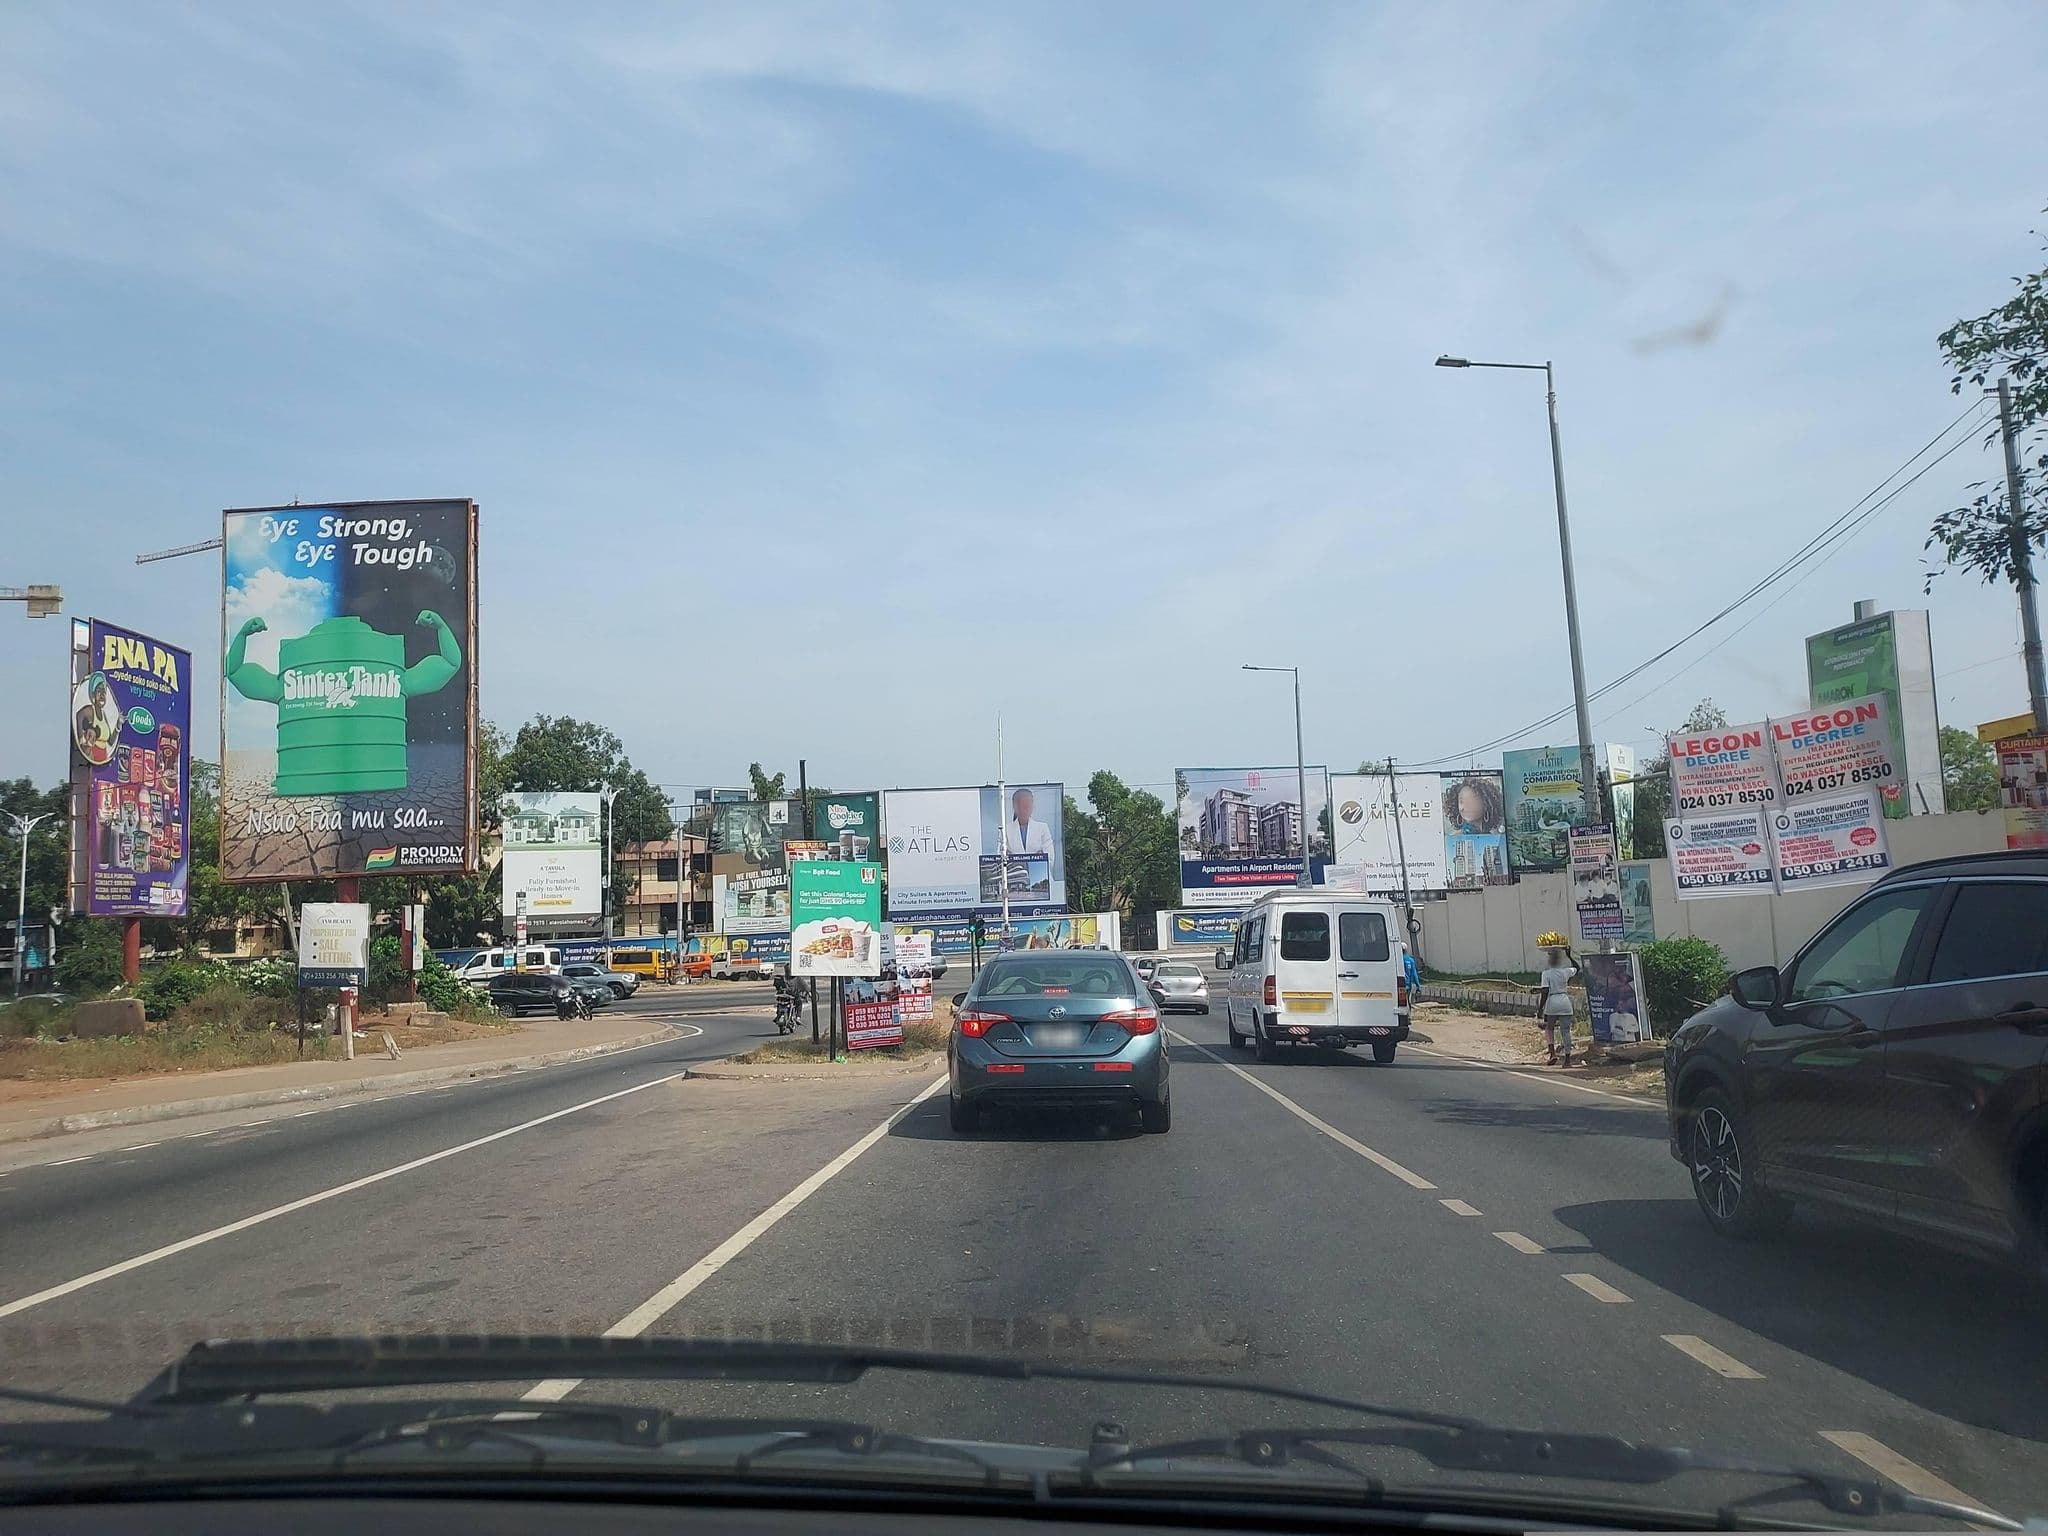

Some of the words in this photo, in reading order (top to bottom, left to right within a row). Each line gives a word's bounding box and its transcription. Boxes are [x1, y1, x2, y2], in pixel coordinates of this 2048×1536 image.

[317, 516, 413, 541] Strong,
[352, 540, 433, 570] Tough
[103, 635, 149, 671] ENA
[153, 646, 179, 692] PA
[284, 669, 348, 700] Sintex
[348, 666, 401, 698] Tank
[1774, 703, 1878, 741] LEGON
[1671, 731, 1761, 757] LEGON
[1792, 723, 1865, 750] DEGREE
[2000, 739, 2041, 750] CURTAIN
[1686, 749, 1750, 767] DEGREE
[1784, 753, 1820, 765] ENTRANCE
[1823, 748, 1844, 758] EXAM
[1805, 753, 1860, 769] REQUIREMENT
[1680, 772, 1712, 781] ENTRANCE
[1714, 769, 1732, 778] EXAM
[1734, 766, 1765, 776] CLASSES
[1786, 772, 1799, 782] NO
[1840, 762, 1853, 771] NO
[1855, 755, 1886, 768] SSSCE
[1524, 773, 1581, 784] COMPARISON!
[1697, 776, 1746, 786] REQUIREMENT
[1785, 779, 1814, 796] 024
[1817, 772, 1846, 790] 037
[1851, 763, 1892, 783] 8530
[1681, 788, 1692, 796] NO
[1728, 782, 1740, 791] NO
[1742, 780, 1769, 789] SSSCE
[1680, 796, 1705, 810] 024
[1708, 792, 1733, 806] 037
[1738, 788, 1775, 803] 8530
[1371, 808, 1431, 820] MRAGE
[1793, 809, 1814, 818] GHANA
[1816, 799, 1869, 815] COMMUNICATION
[1795, 815, 1832, 826] TECHNOLOGY
[1834, 807, 1869, 819] UNIVERSITY
[248, 808, 298, 835] Nsuo
[304, 806, 342, 832] Taa
[352, 809, 385, 830] mu
[393, 807, 444, 829] saa...
[1691, 824, 1709, 832] GHANA
[1710, 818, 1757, 830] COMMUNICATION
[911, 826, 932, 835] THE
[1691, 829, 1725, 839] TECHNOLOGY
[1726, 826, 1757, 835] UNIVERSITY
[401, 847, 465, 858] PROUDLY
[907, 836, 970, 854] ATLAS
[1202, 863, 1240, 874] Apartments
[1241, 863, 1248, 871] in
[1249, 862, 1272, 873] Airport
[1404, 860, 1435, 869] partments
[1784, 865, 1811, 877] 050
[1814, 860, 1840, 872] 087
[1846, 854, 1882, 868] 2418
[730, 881, 750, 892] PUSH
[751, 875, 787, 889] YOURSELF
[736, 873, 745, 881] WE
[745, 871, 759, 880] FUEL
[1410, 872, 1430, 880] Airport
[1682, 876, 1704, 885] 050
[1707, 873, 1730, 882] 087
[1734, 870, 1768, 881] 2418
[934, 890, 967, 899] Apartments
[954, 897, 974, 905] Airport
[892, 914, 961, 922] www.atlasghana.com
[320, 939, 338, 950] SALE
[318, 952, 352, 964] LETTING
